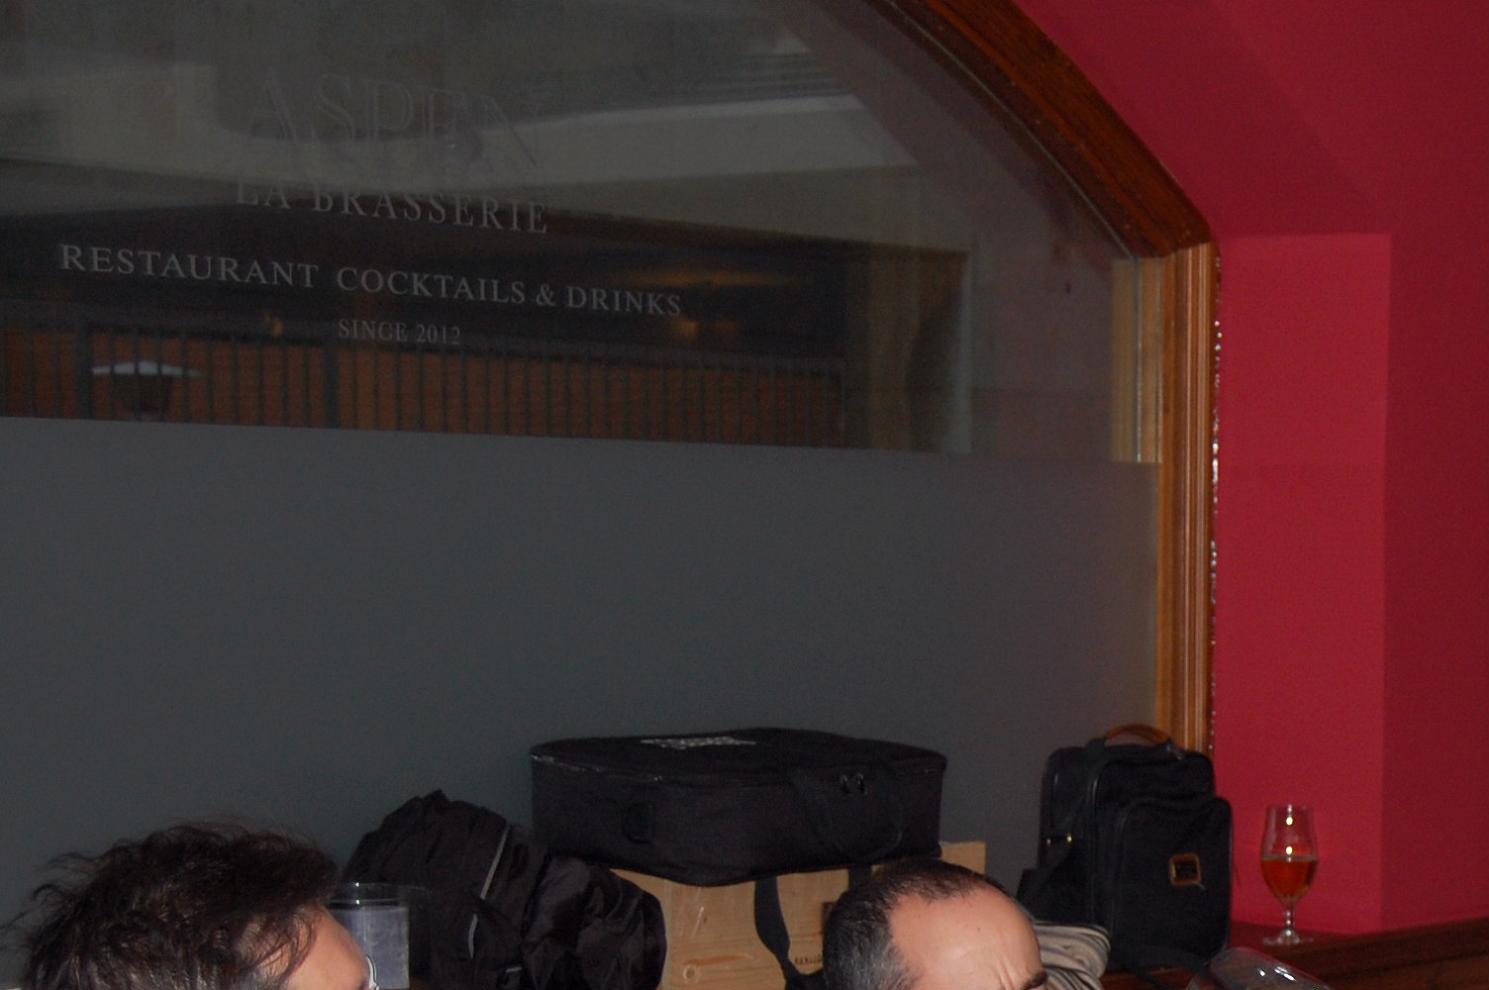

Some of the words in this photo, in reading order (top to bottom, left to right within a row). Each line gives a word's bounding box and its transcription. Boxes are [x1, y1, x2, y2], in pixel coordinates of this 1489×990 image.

[236, 179, 292, 210] LA
[312, 186, 549, 235] BRASSERIE
[60, 243, 319, 289] RESTAURANT
[336, 265, 526, 306] COCKTAILS
[535, 283, 557, 308] &
[566, 285, 682, 317] DRINKS
[337, 318, 409, 343] SINCE
[416, 322, 462, 345] 2012
